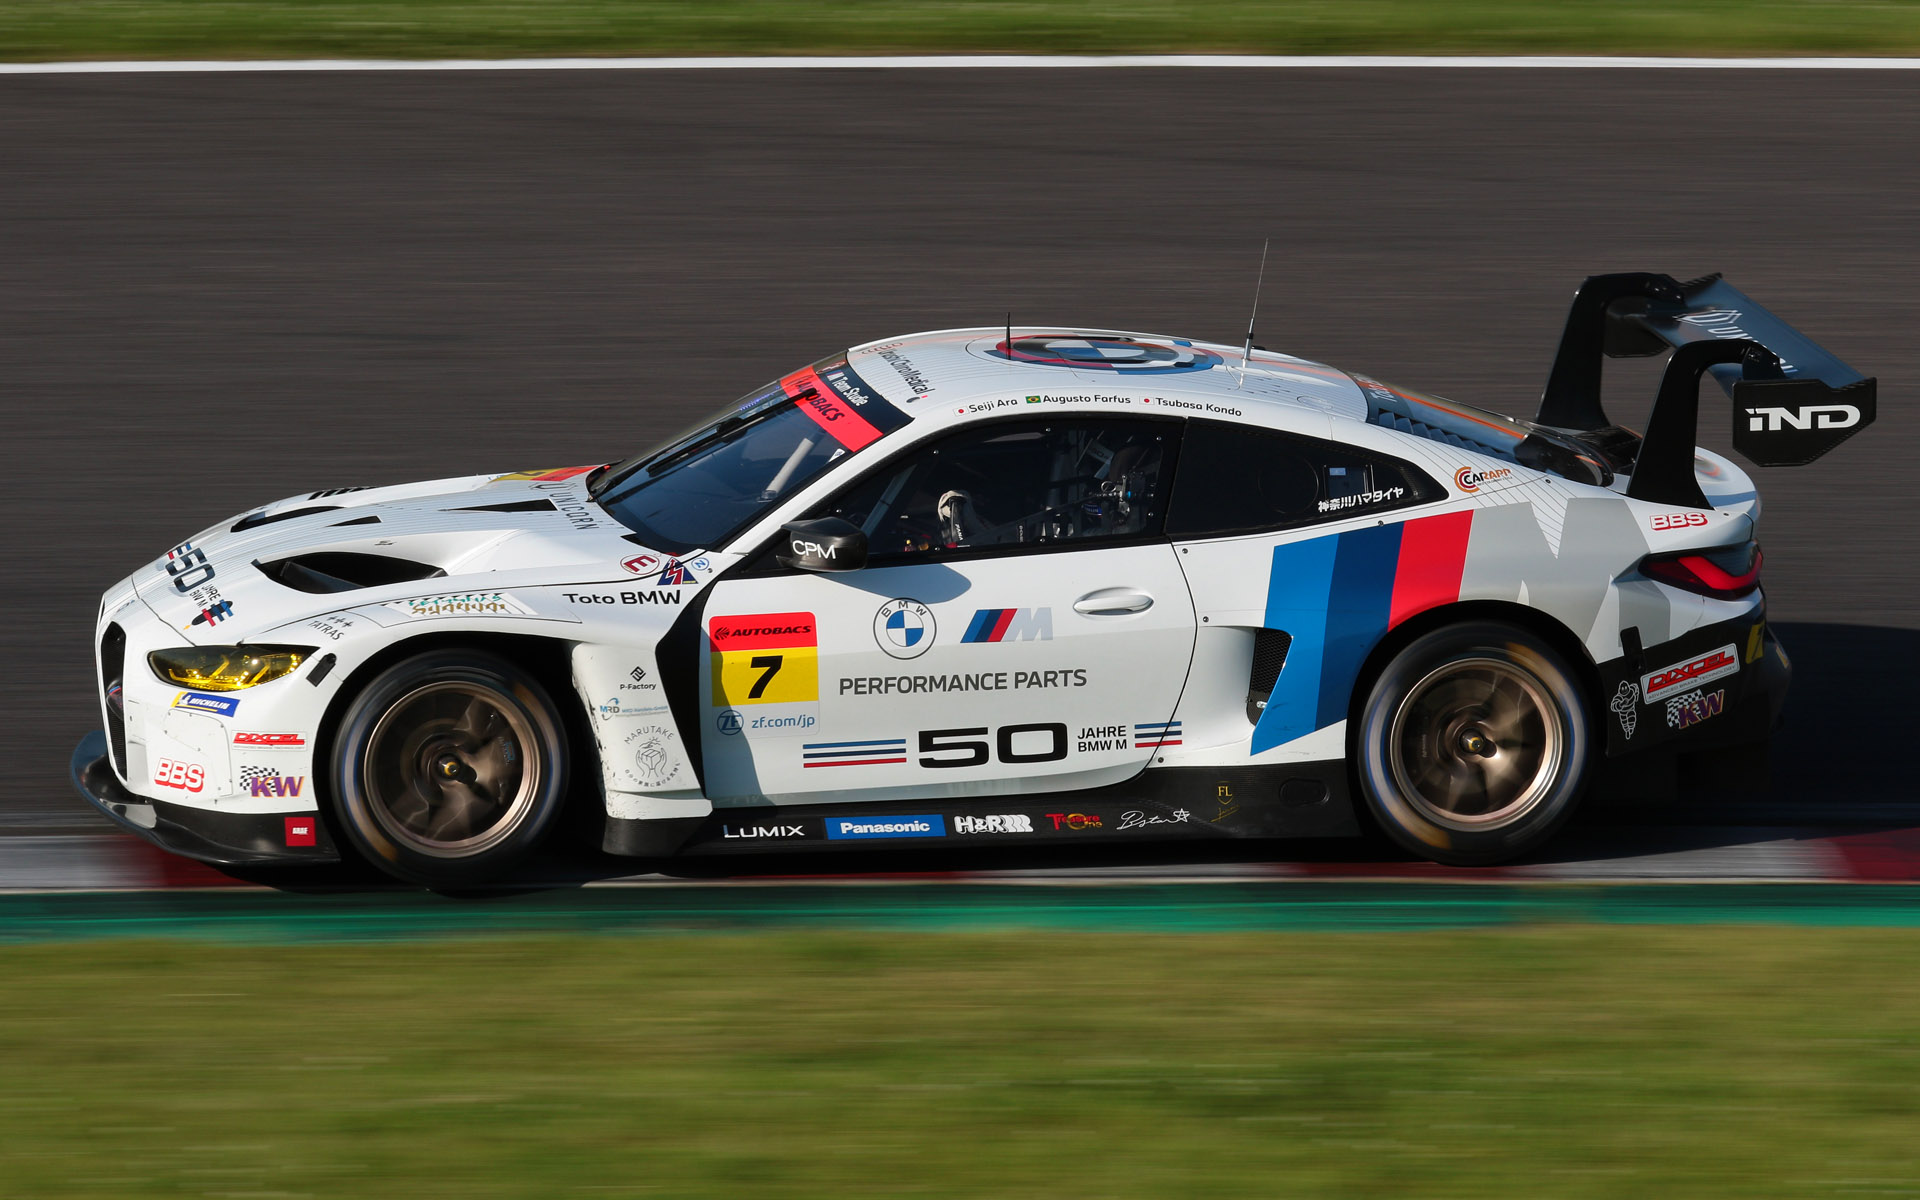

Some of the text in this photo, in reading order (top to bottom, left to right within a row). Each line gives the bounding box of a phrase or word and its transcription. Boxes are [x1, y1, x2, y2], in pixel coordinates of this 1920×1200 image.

[795, 379, 845, 421] AUOBACS
[968, 399, 1018, 413] Seiji Ara
[1043, 394, 1131, 405] Augusto Farfus
[1155, 397, 1242, 417] Tsubasa Kondo
[1318, 487, 1404, 513] 神奈川ハマタイヤ
[549, 491, 600, 530] UNICORN
[1650, 511, 1708, 531] BBS
[792, 540, 836, 559] CPM
[165, 547, 215, 593] 50
[562, 589, 681, 605] Toto BMW
[880, 600, 928, 618] BMW
[307, 620, 345, 641] TATRAS
[731, 625, 812, 637] AUTOBACS
[747, 655, 784, 699] 7
[1647, 650, 1735, 694] DIXCEL
[620, 683, 657, 691] P-Factory
[839, 668, 1087, 696] PERFORMANCE PARTS
[189, 697, 231, 710] MICHELIN
[600, 705, 620, 714] MRD
[1679, 689, 1724, 729] KW
[751, 714, 815, 729] zf.com/jp
[233, 732, 306, 746] DIXCEL
[624, 726, 674, 745] MARUTAKE
[1077, 725, 1127, 740] JAHRE
[918, 722, 1068, 769] 50
[1078, 739, 1128, 752] BMW M
[154, 758, 205, 792] BBS
[250, 776, 305, 798] KW
[1218, 785, 1233, 797] FL
[723, 825, 806, 838] LUMIX
[840, 820, 931, 834] Panasonic
